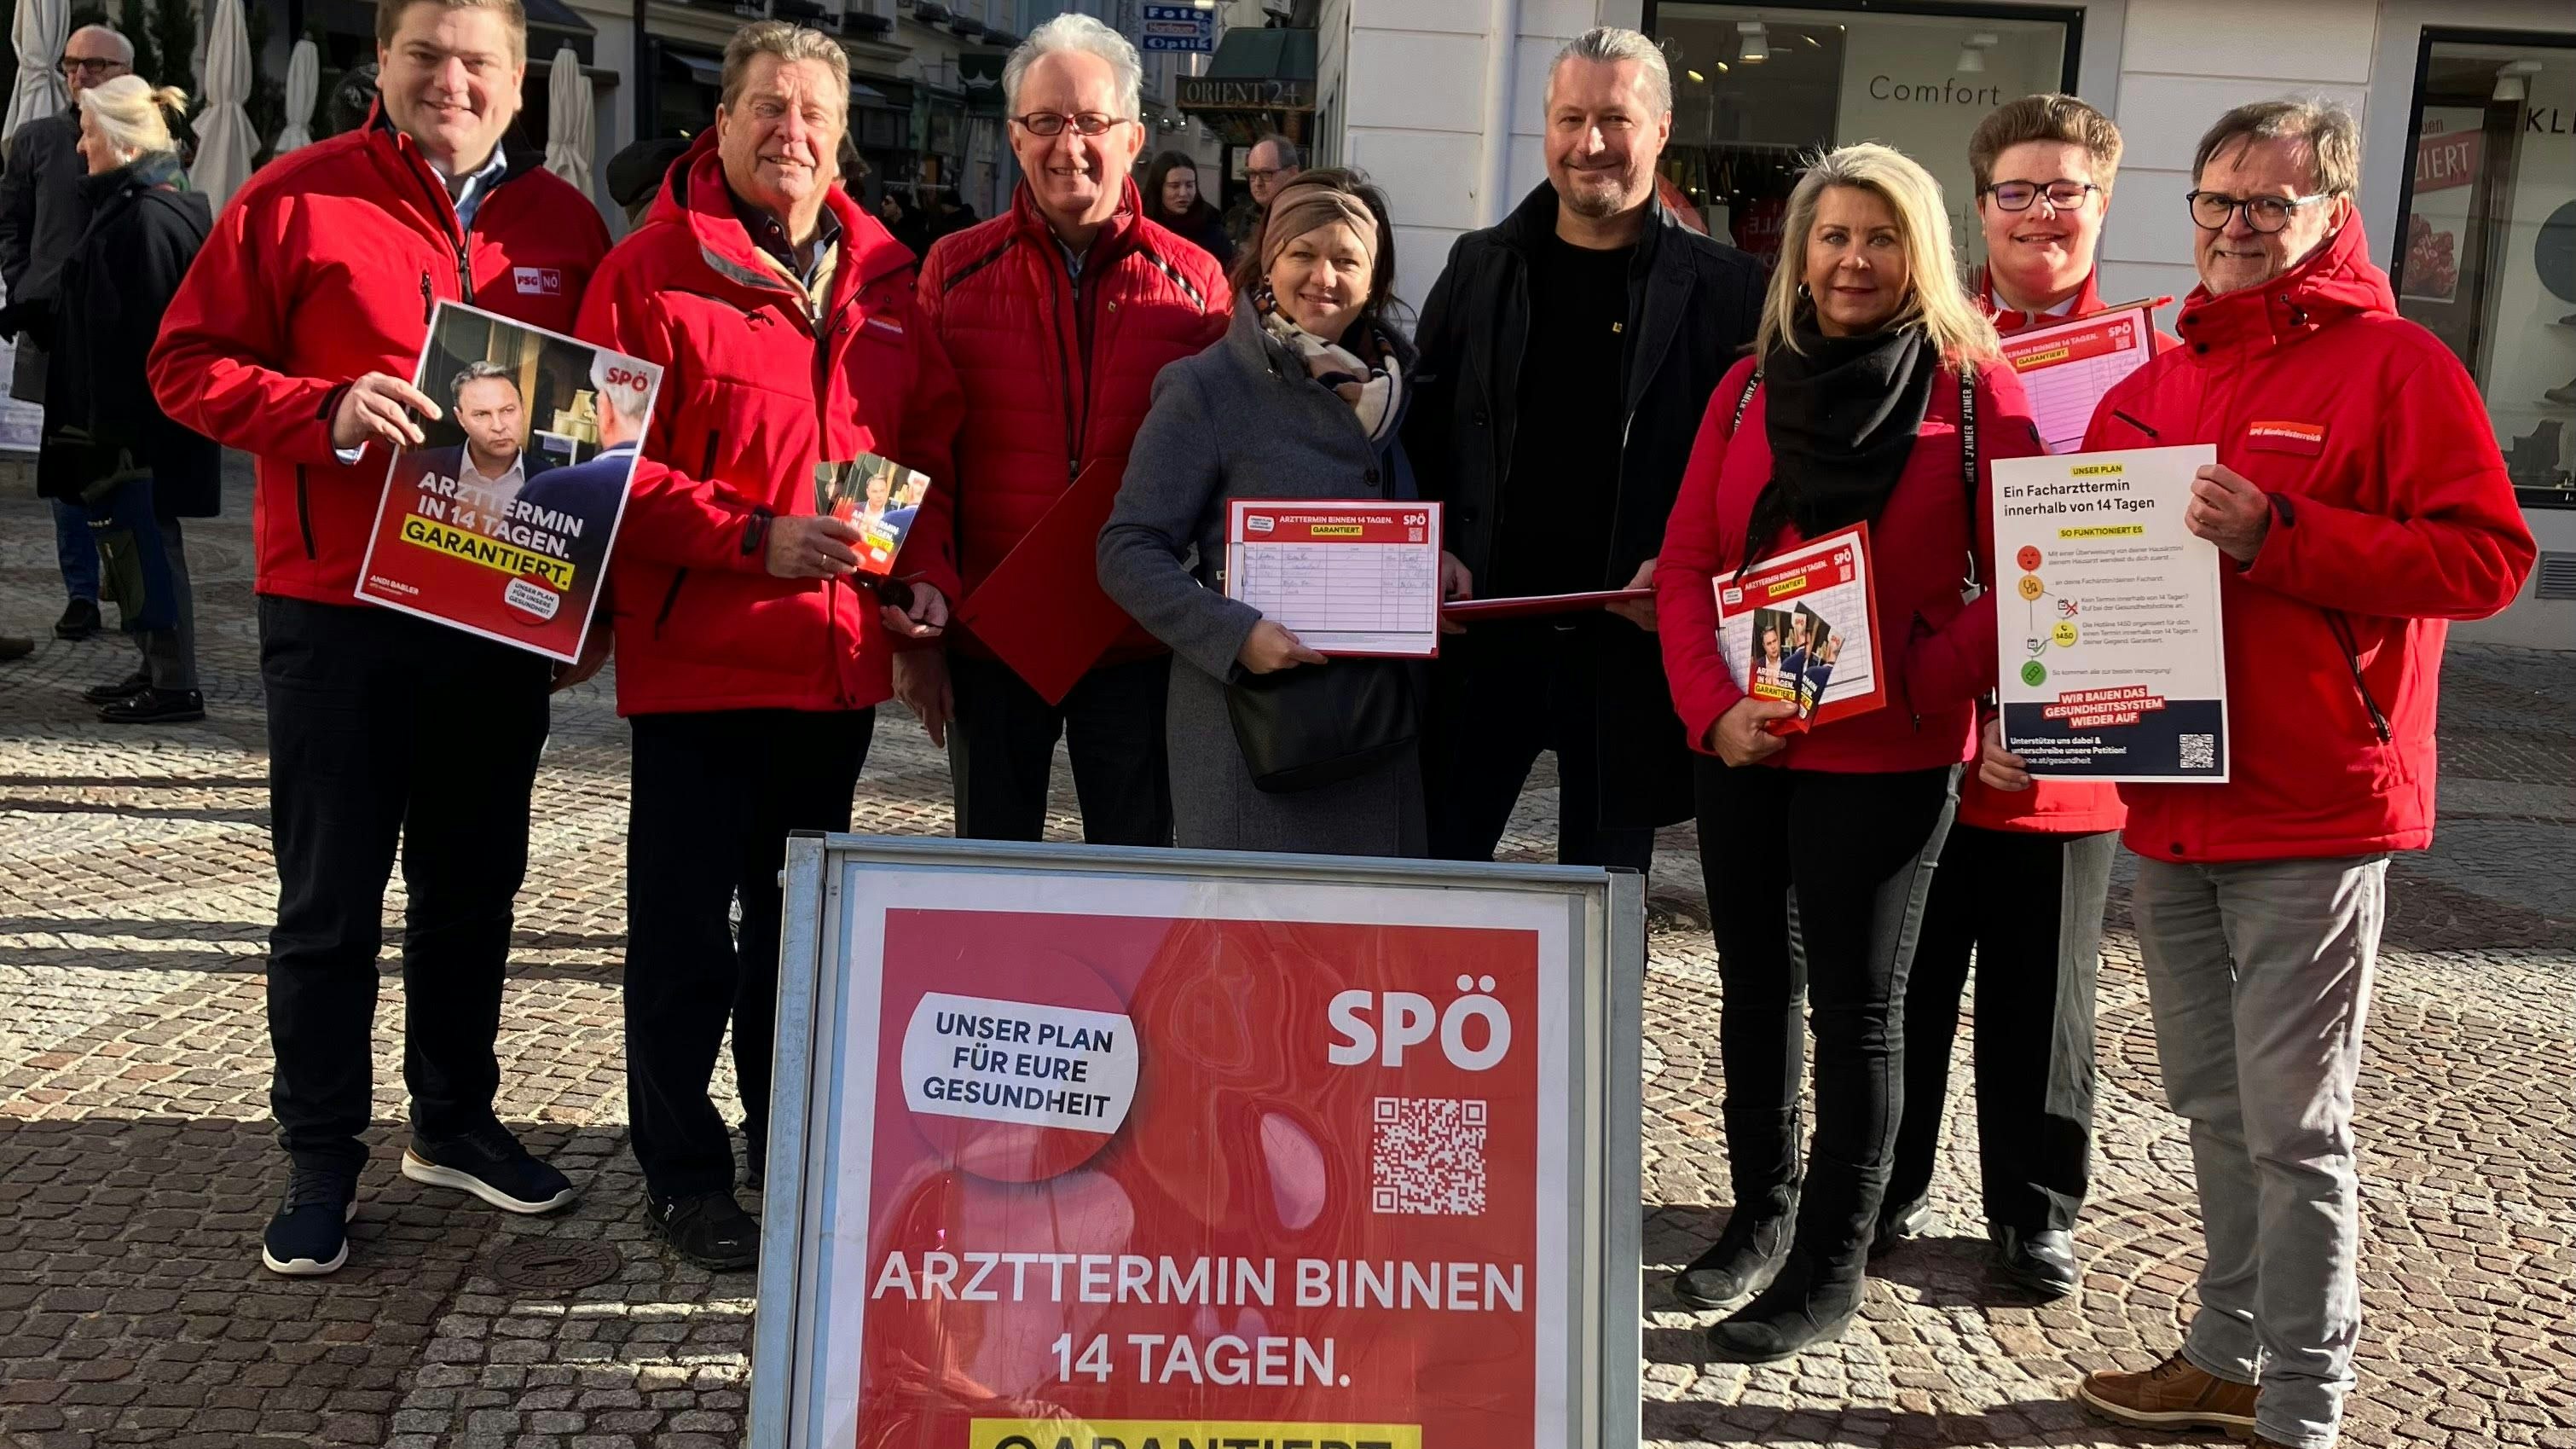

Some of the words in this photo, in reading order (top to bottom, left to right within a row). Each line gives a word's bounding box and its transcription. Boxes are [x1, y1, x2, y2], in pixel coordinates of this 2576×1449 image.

[1148, 7, 1205, 19] Foto
[1148, 38, 1208, 49] Optik
[1186, 82, 1262, 102] ORIENT
[1869, 75, 2000, 107] Comfort
[2526, 107, 2576, 135] KL
[542, 273, 558, 288] NÖ
[2108, 321, 2132, 338] SPÖ
[605, 367, 649, 392] SPÖ
[1962, 389, 1973, 421] J'AIMER
[1964, 425, 1975, 458] J'AIMER
[2073, 467, 2099, 475] UNSER
[2004, 485, 2024, 498] Ein
[2027, 479, 2130, 496] Facharzttermin
[417, 471, 583, 538] ARZTTERMIN
[2004, 501, 2067, 517] innerhalb
[2069, 501, 2094, 513] von
[2097, 499, 2111, 511] 14
[2114, 498, 2155, 512] Tagen
[418, 495, 447, 520] IN
[450, 505, 476, 530] 14
[482, 514, 570, 559] TAGEN.
[1279, 515, 1327, 524] ARZTTERMIN
[1404, 513, 1426, 525] SPÖ
[2060, 529, 2073, 537] SO
[2074, 527, 2131, 536] FUNKTIONIERT
[2133, 525, 2143, 534] ES
[405, 520, 568, 587] GARANTIERT.
[1834, 548, 1852, 566] SPÖ
[512, 588, 526, 598] FÜR
[526, 594, 552, 608] UNSERE
[515, 582, 537, 594] UNSER
[537, 591, 554, 602] PLAN
[508, 595, 551, 616] GESUNDHEIT
[2061, 693, 2084, 704] WIR
[2085, 689, 2122, 702] BAUEN
[2123, 687, 2145, 698] DAS
[2045, 698, 2163, 717] GESUNDHEITSSYSTEM
[2070, 714, 2114, 727] WIEDER
[2115, 712, 2138, 723] AUF
[2093, 745, 2127, 754] Petition!
[936, 1011, 1032, 1044] UNSER
[1037, 1023, 1114, 1053] PLAN
[1327, 973, 1513, 1072] SPÖ
[952, 1041, 1009, 1074] FÜR
[1015, 1053, 1088, 1083] EURE
[923, 1076, 1111, 1118] GESUNDHEIT
[871, 1250, 1276, 1307] ARZTTERMIN
[1295, 1258, 1525, 1313] BINNEN
[1051, 1332, 1114, 1384] 14
[1127, 1334, 1352, 1388] TAGEN.
